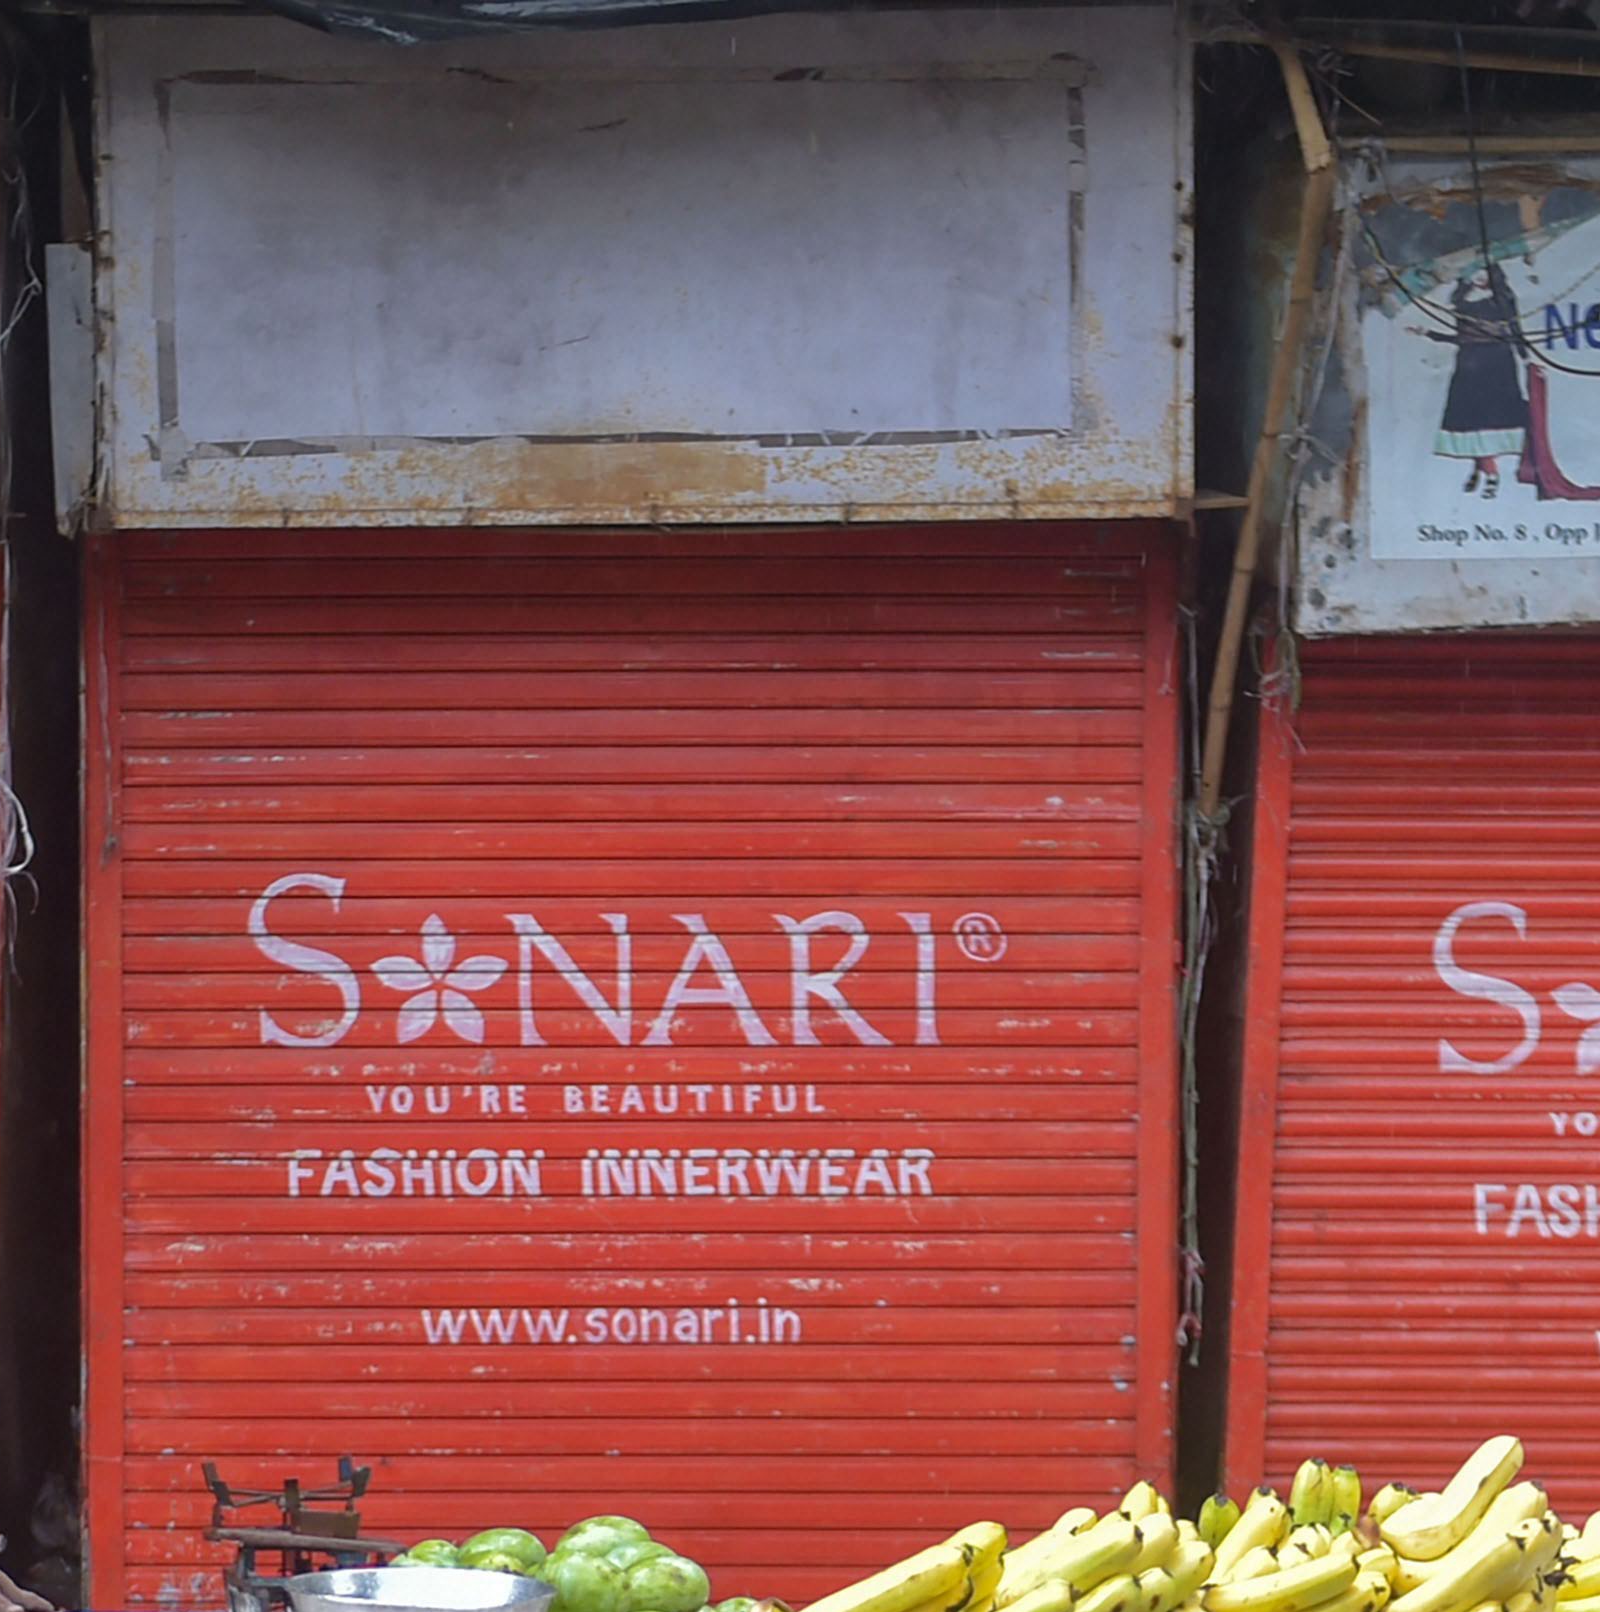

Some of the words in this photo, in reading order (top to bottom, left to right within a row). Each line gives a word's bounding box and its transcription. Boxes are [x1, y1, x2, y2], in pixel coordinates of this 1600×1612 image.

[1416, 524, 1469, 547] Shop
[1474, 523, 1509, 542] No.
[1514, 524, 1528, 542] 8
[1544, 523, 1589, 545] Opp
[365, 1084, 528, 1114] YOU'RE
[563, 1084, 826, 1114] BEAUTIFUL
[287, 1148, 546, 1198] FASHION
[580, 1148, 937, 1198] INNERWEAR
[421, 1297, 802, 1346] www.sonari.in
